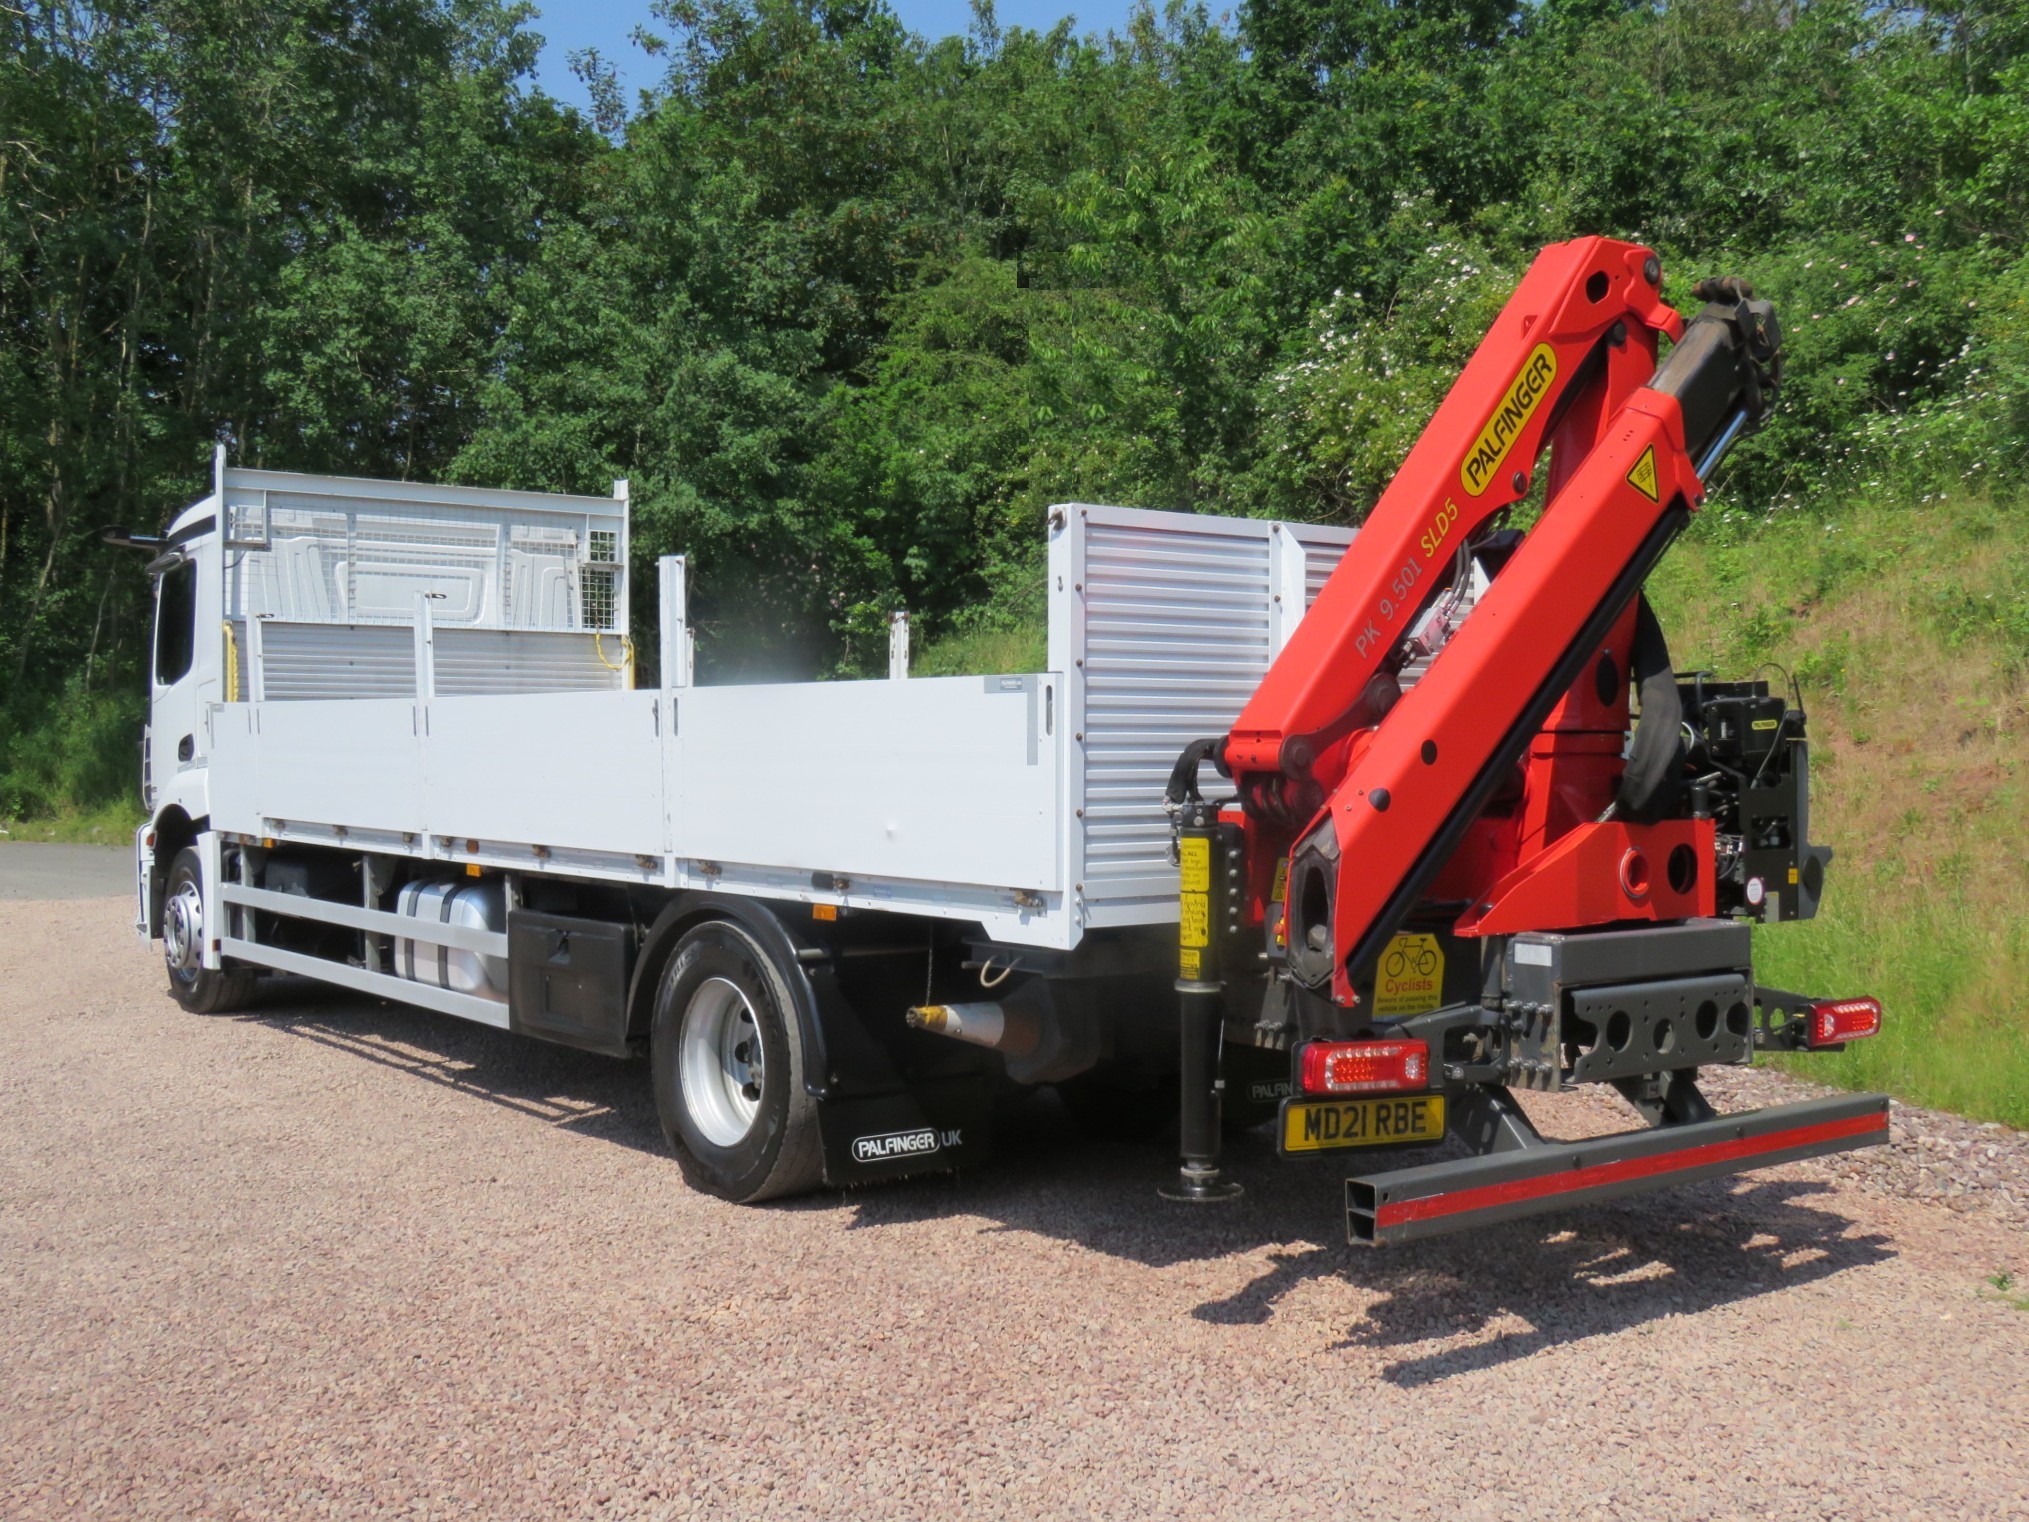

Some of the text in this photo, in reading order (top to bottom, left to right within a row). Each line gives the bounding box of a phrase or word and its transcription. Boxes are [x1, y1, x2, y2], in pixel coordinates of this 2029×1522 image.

[1466, 353, 1552, 488] PALFINGER
[1355, 497, 1458, 658] PK 9.501 SLD5
[1385, 978, 1433, 995] Cyclists
[1252, 1083, 1292, 1099] PALFIN
[1304, 1101, 1427, 1141] MD21 RBE
[858, 1129, 962, 1158] PALFINGER UK
